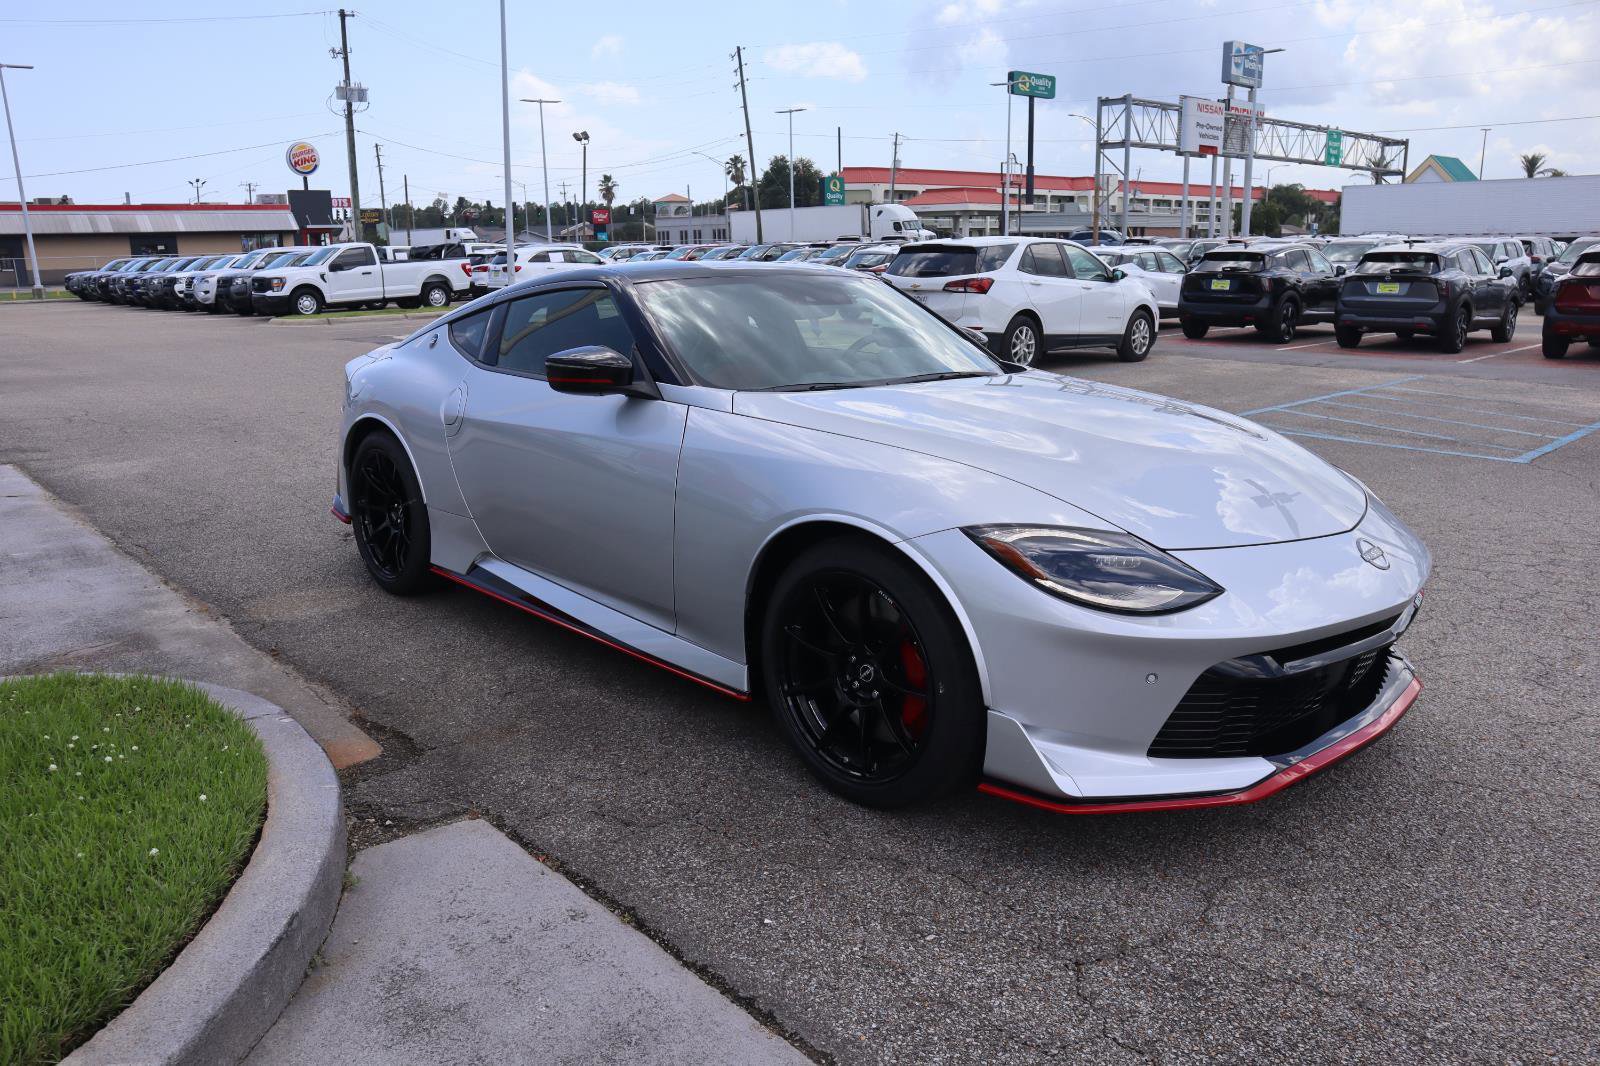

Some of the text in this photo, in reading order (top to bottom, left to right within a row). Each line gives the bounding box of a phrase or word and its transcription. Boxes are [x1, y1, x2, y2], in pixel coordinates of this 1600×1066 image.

[1030, 76, 1052, 88] Quality
[1197, 103, 1223, 115] NISSAN
[1196, 121, 1222, 132] Pre-Owned
[1199, 132, 1219, 141] Vehicles
[291, 148, 315, 160] BURGER
[293, 155, 317, 168] KING
[826, 192, 843, 200] Quality
